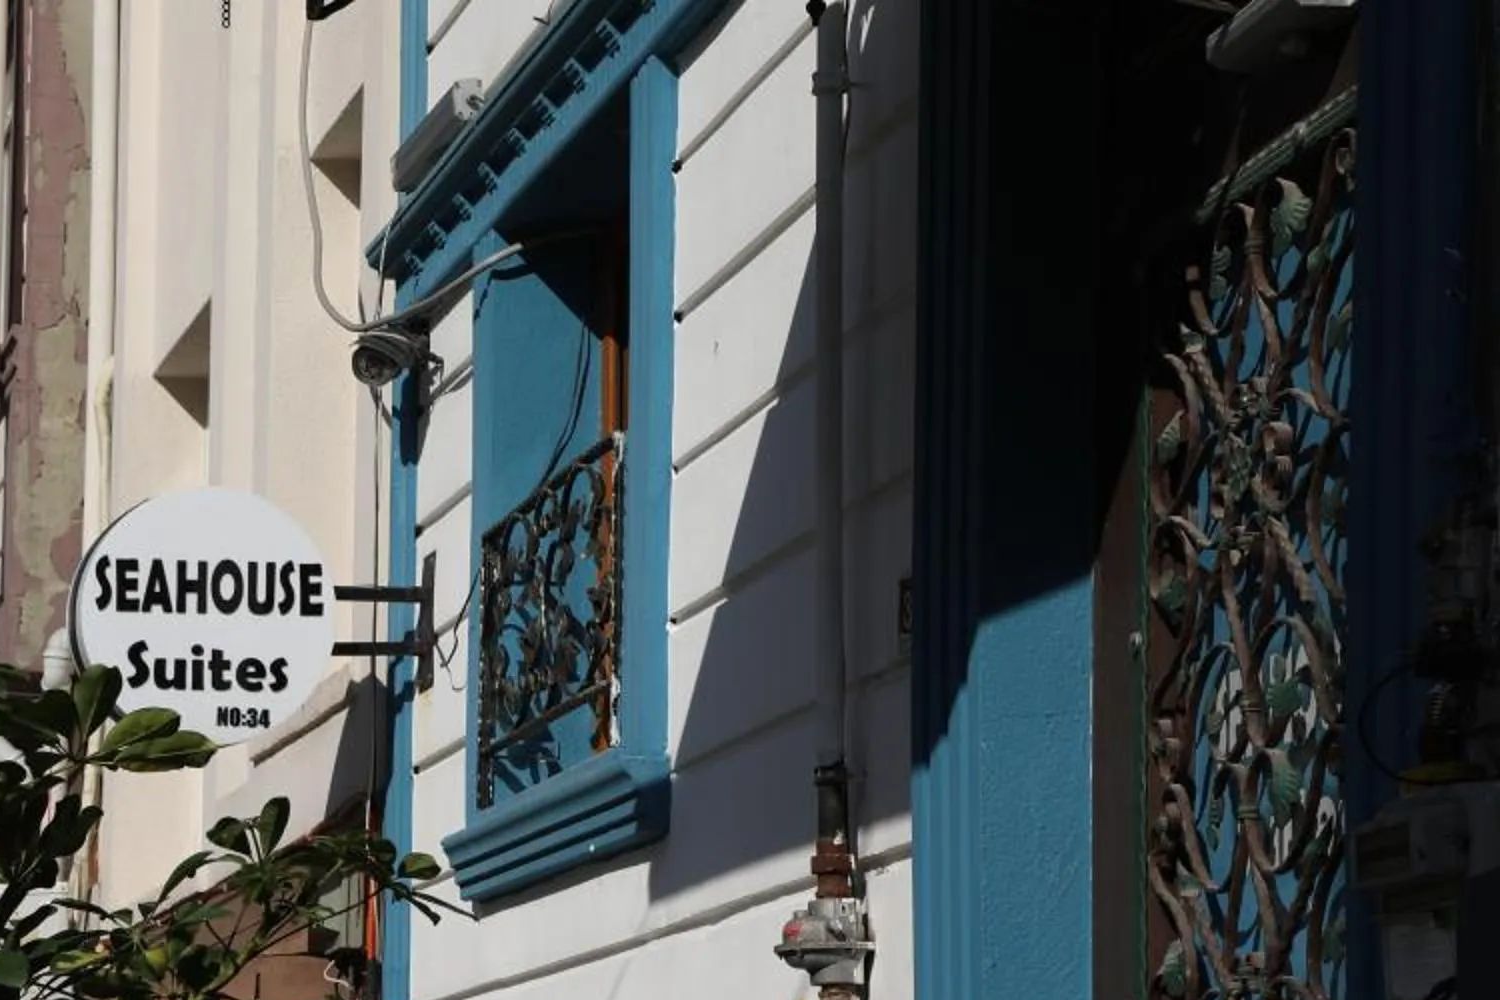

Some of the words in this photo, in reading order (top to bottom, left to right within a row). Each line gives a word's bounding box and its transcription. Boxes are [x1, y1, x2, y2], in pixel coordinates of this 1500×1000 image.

[95, 555, 325, 617] SEAHOUSE
[126, 639, 290, 693] Suites
[216, 706, 271, 729] NO:34
